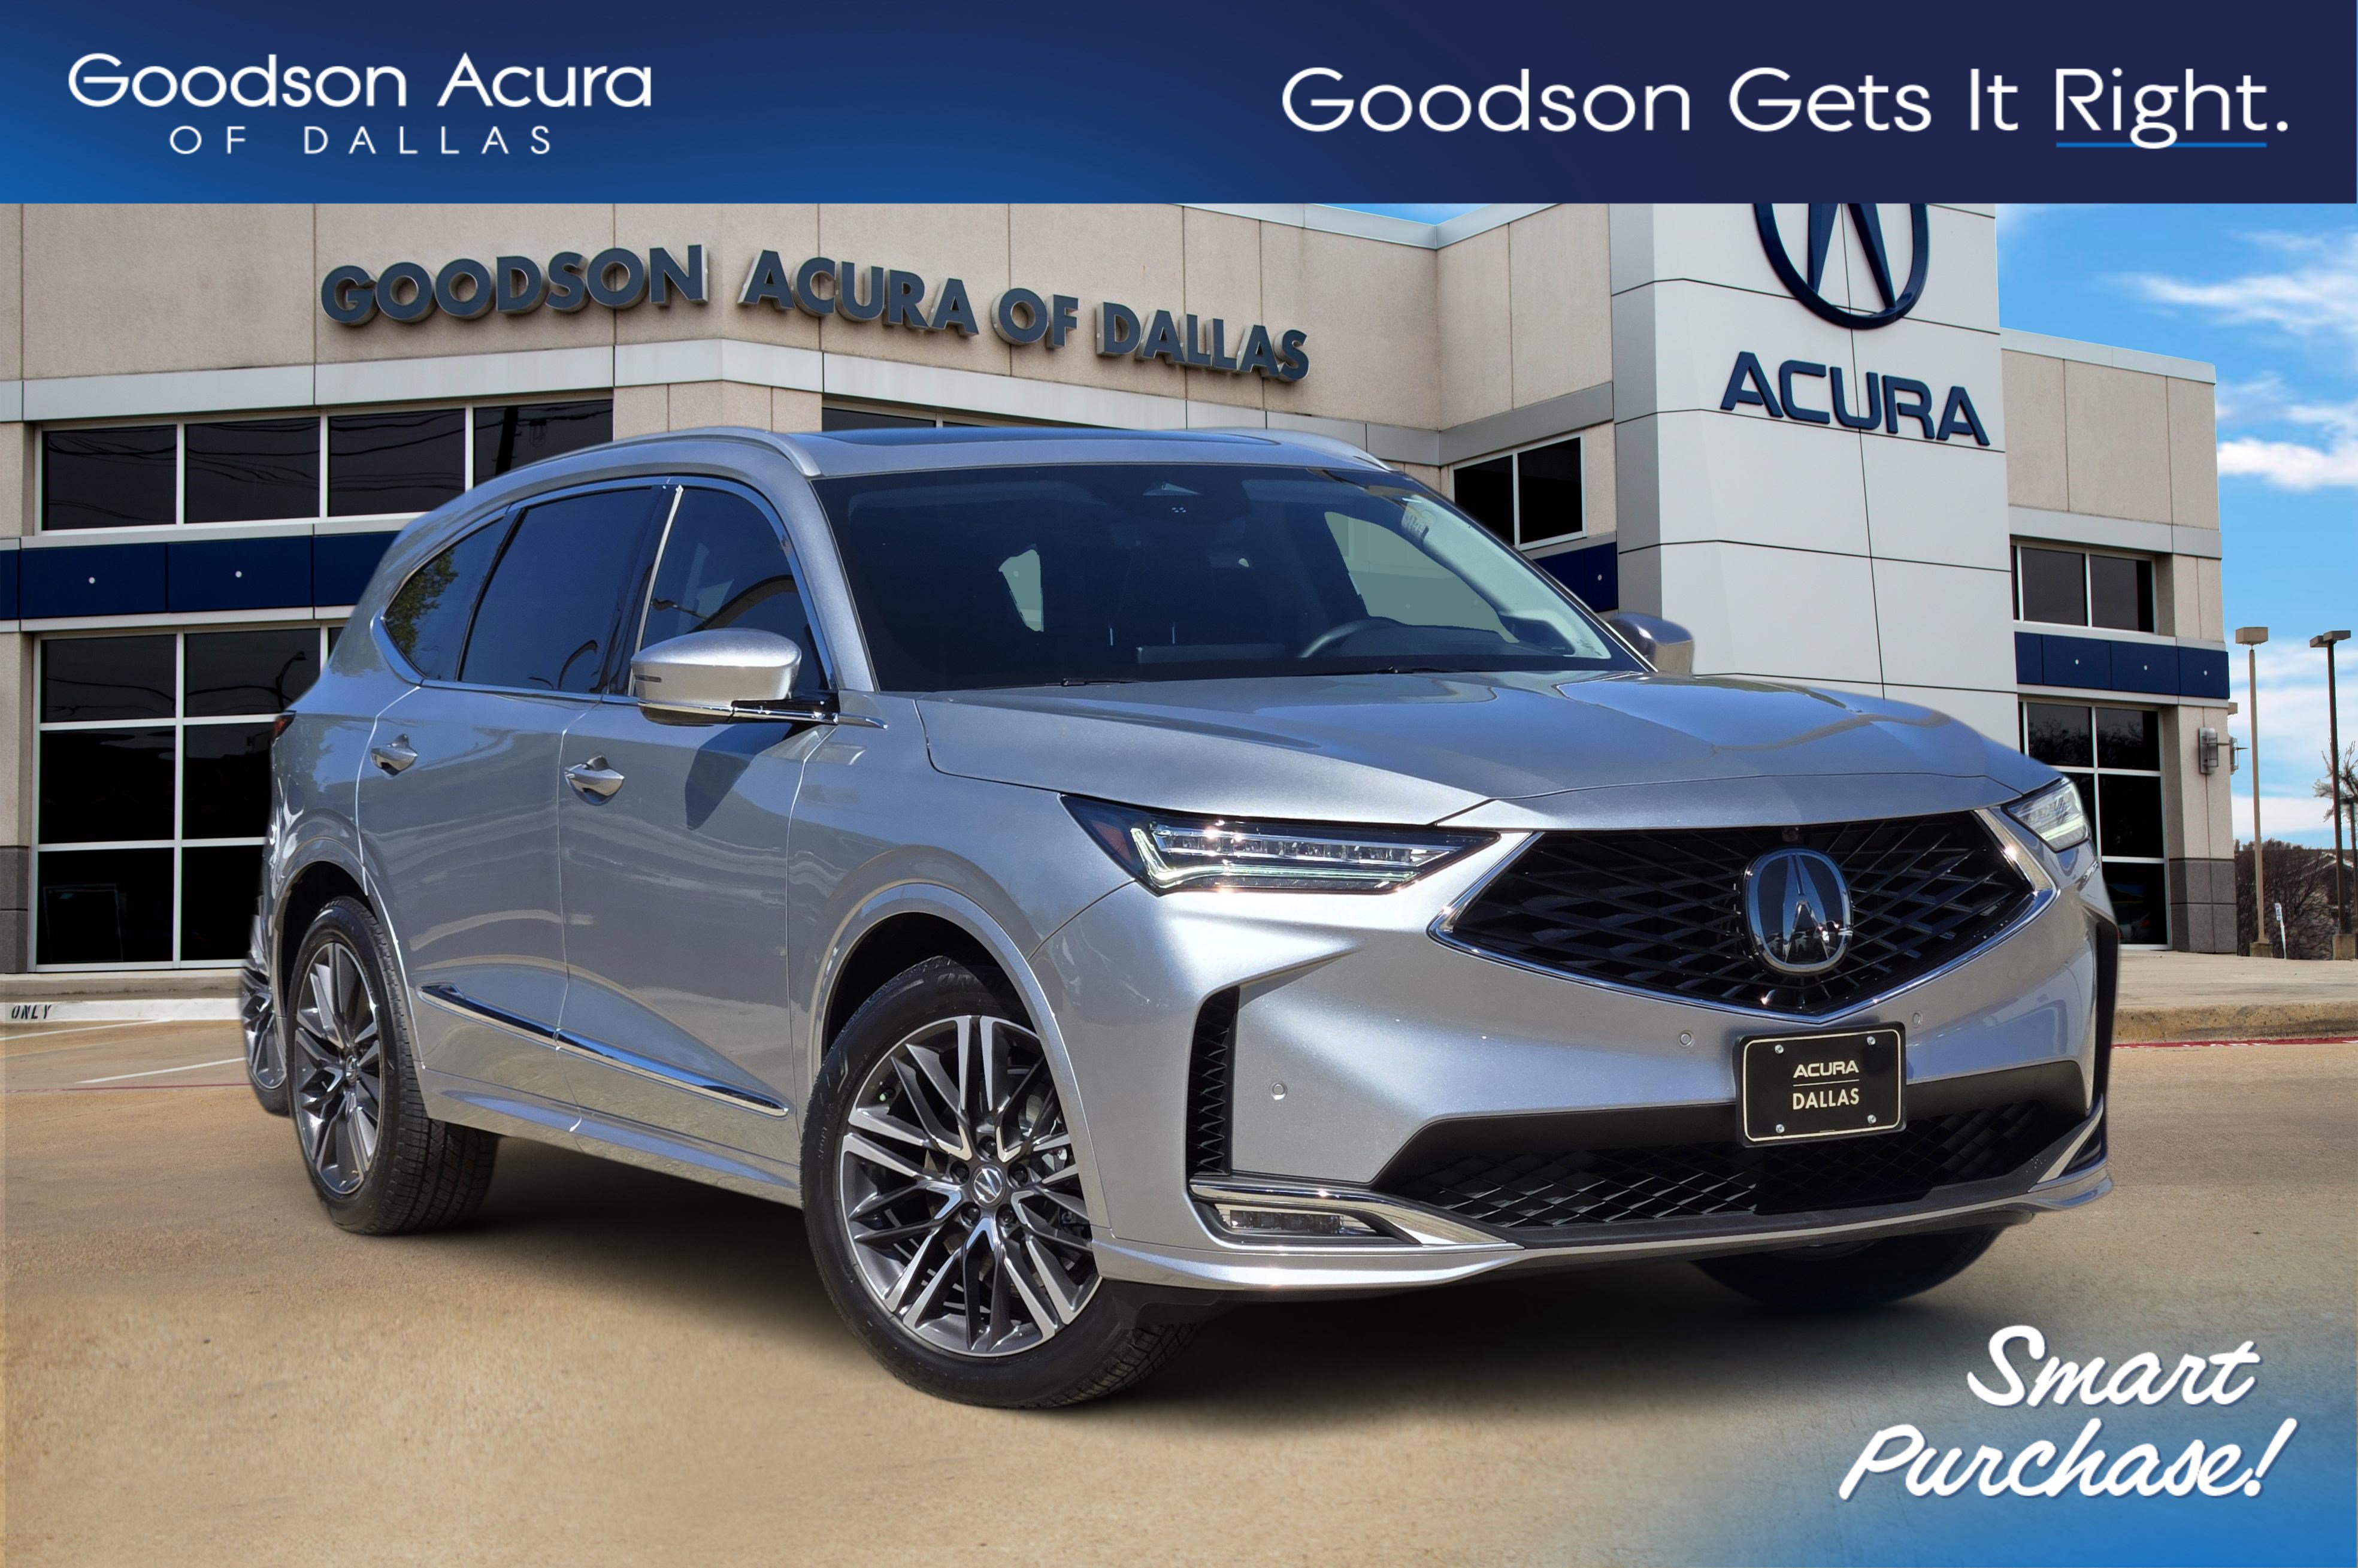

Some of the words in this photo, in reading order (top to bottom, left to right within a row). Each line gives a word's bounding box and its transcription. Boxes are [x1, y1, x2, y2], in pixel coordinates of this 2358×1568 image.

[321, 244, 708, 325] GOODSON
[737, 249, 979, 337] ACURA
[991, 287, 1078, 350] OF
[1096, 301, 1310, 382] DALLAS
[1720, 351, 1990, 446] ACURA
[11, 1004, 52, 1019] ONLY
[1793, 1060, 1859, 1078] ACURA
[1793, 1088, 1860, 1110] DALLAS
